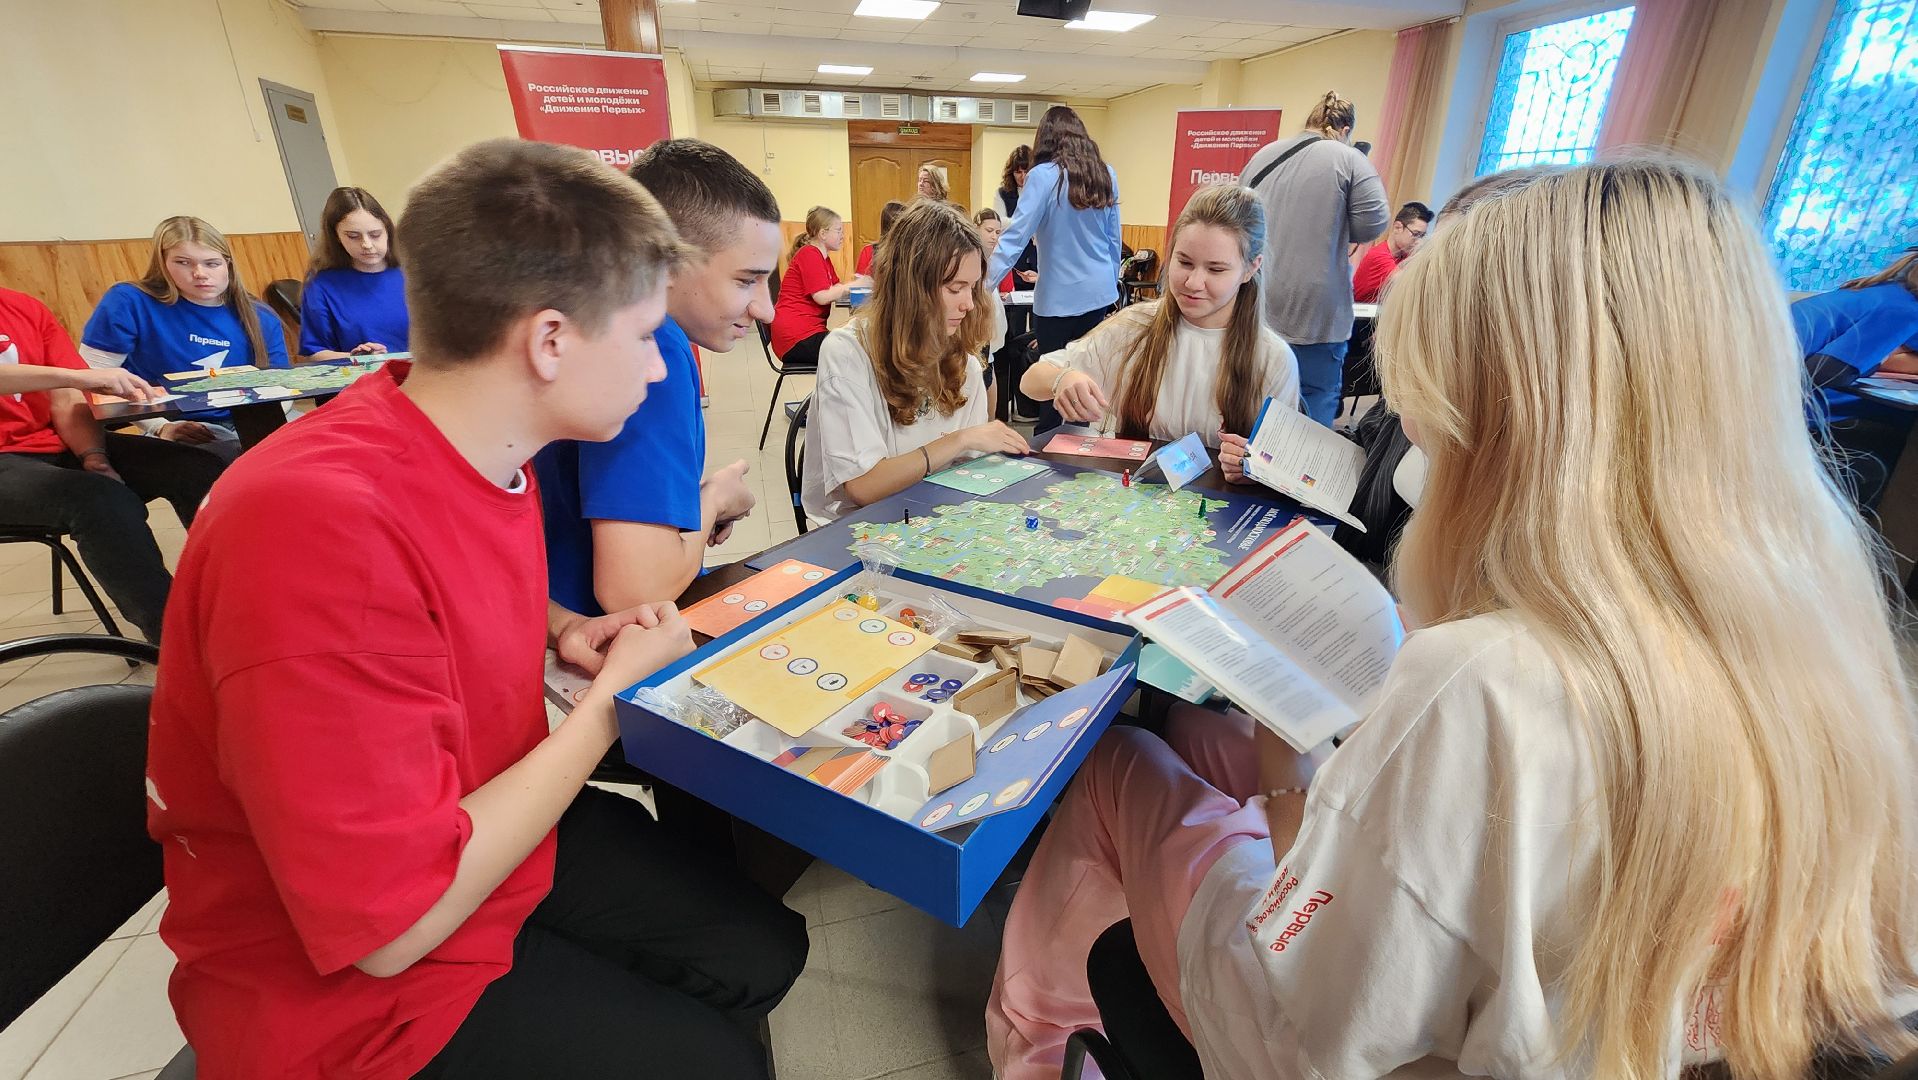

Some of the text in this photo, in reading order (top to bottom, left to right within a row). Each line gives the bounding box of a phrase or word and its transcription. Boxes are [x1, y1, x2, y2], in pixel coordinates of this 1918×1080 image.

[528, 82, 649, 95] Российское движение
[543, 94, 575, 103] детей
[585, 96, 640, 105] молодёжи
[540, 104, 646, 115] «Движение Первых»
[1190, 169, 1241, 184] Первы
[190, 333, 231, 347] Первые
[1254, 876, 1299, 924] Российское
[1269, 890, 1334, 952] Первые
